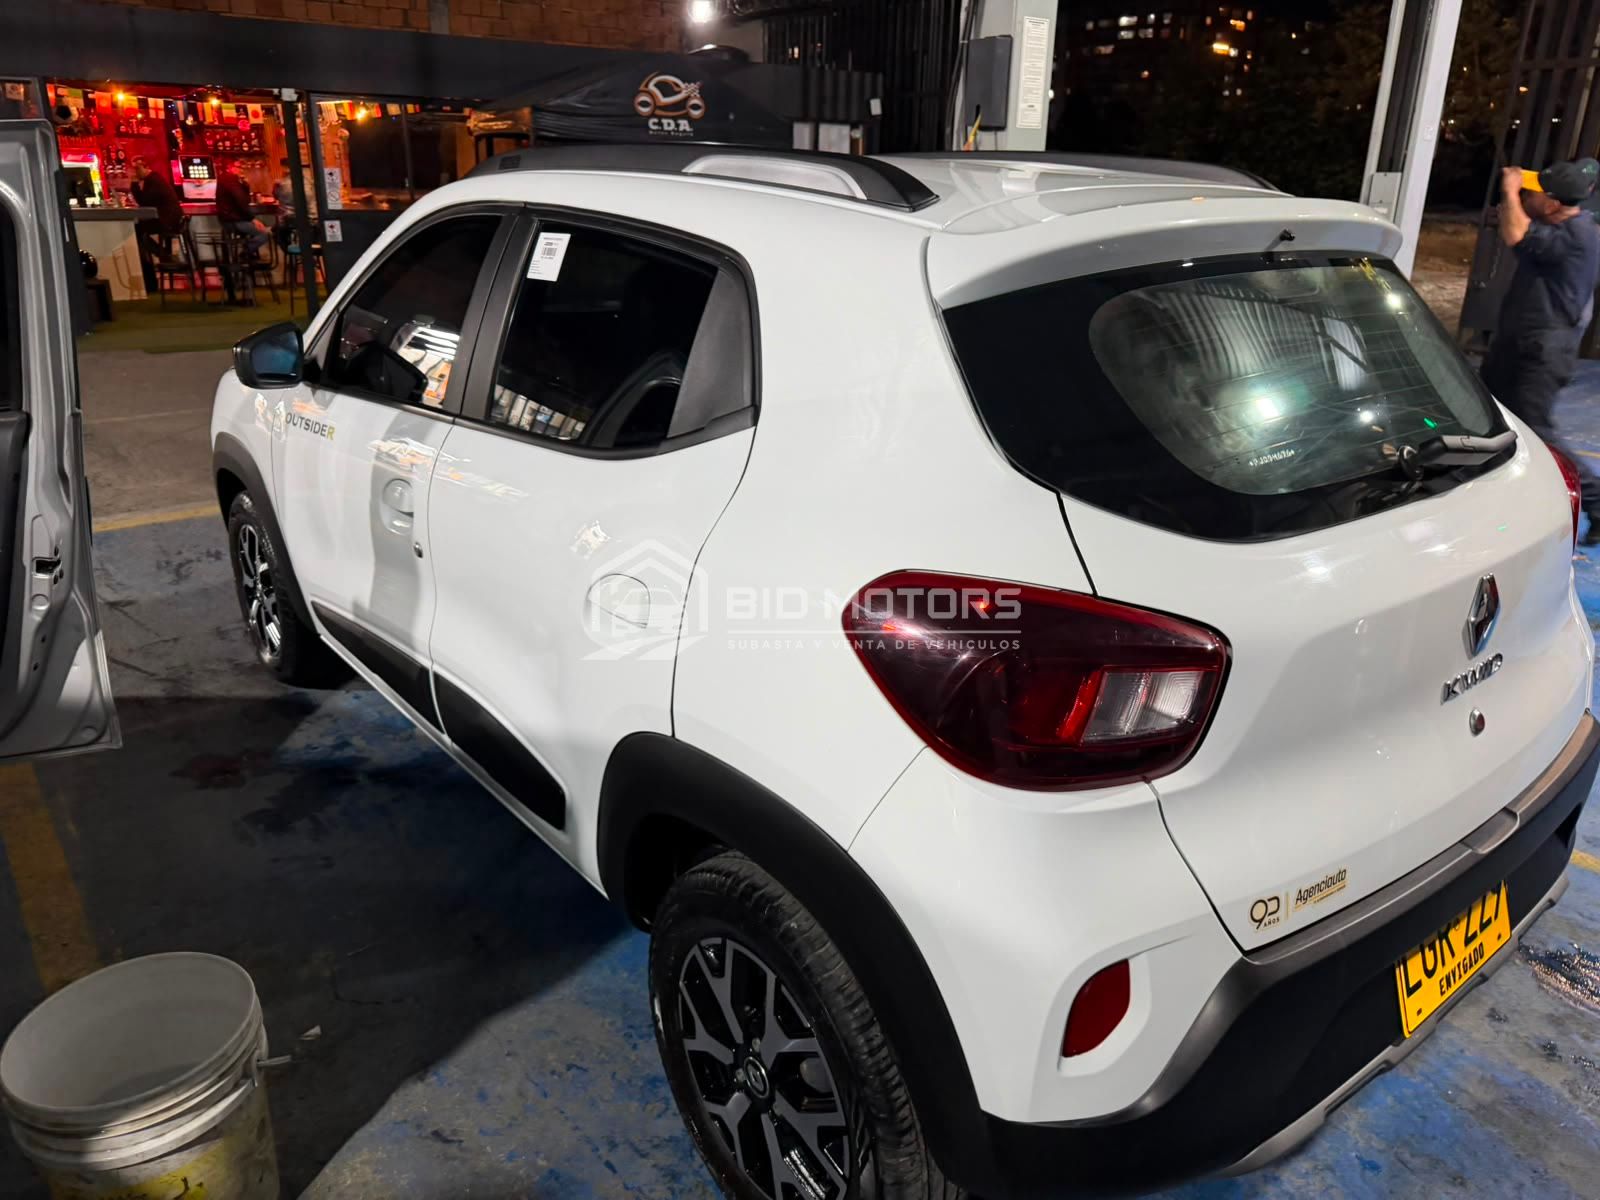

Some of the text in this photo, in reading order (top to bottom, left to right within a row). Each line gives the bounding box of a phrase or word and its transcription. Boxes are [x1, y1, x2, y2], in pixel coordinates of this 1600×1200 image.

[285, 412, 336, 441] OUTSIDER
[1440, 652, 1503, 705] KWID
[1295, 867, 1347, 905] Agenciauto
[1439, 942, 1484, 996] ENVIGADO
